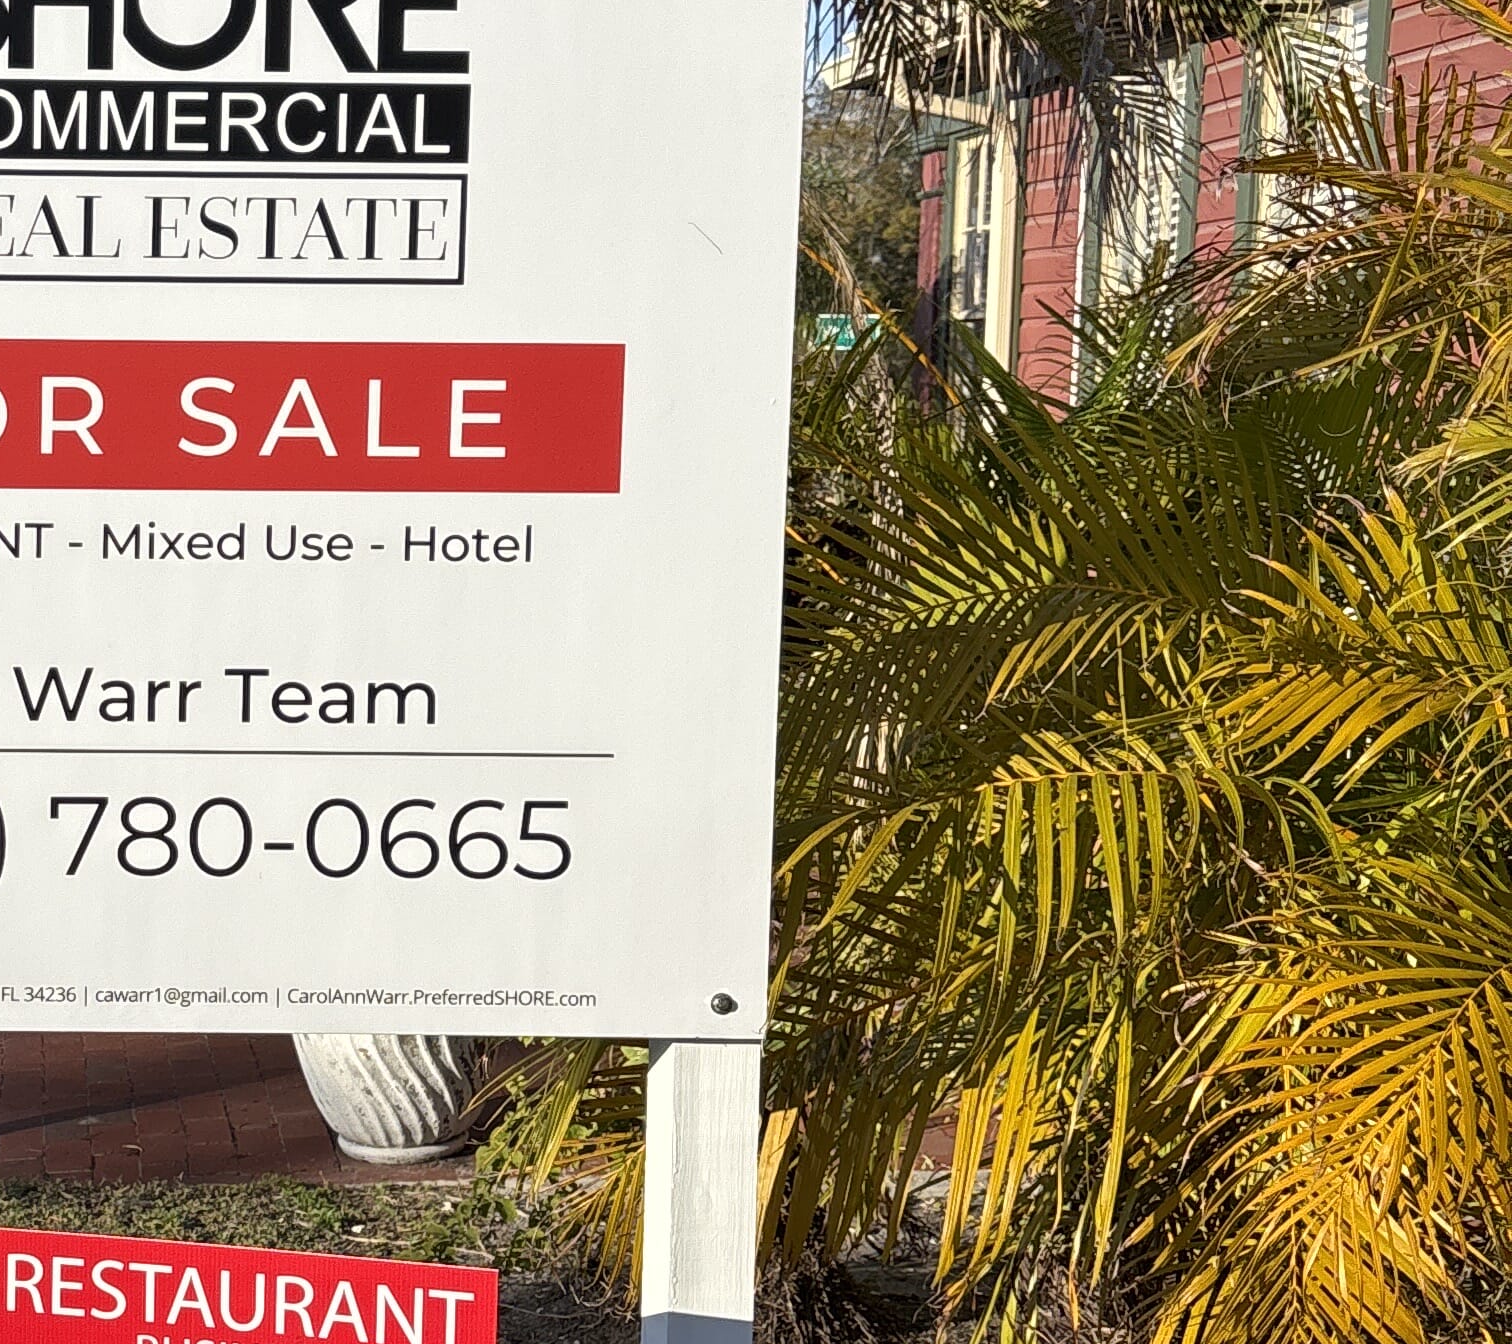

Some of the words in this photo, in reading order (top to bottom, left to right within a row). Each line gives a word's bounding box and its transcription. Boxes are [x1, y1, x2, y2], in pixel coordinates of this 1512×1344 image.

[145, 196, 449, 262] ESTATE
[177, 377, 508, 459] SALE
[101, 521, 246, 562] Mixed
[265, 524, 355, 562] Use
[403, 524, 533, 564] Hotel
[13, 666, 203, 724] Warr
[224, 668, 437, 726] Team
[49, 796, 573, 882] 780-0665
[1, 986, 20, 1002] FL
[24, 986, 77, 1003] 34236
[95, 987, 268, 1007] cawarr1@gmail.com
[287, 988, 596, 1007] CarolAnnWarr.PreferredSHORE.com
